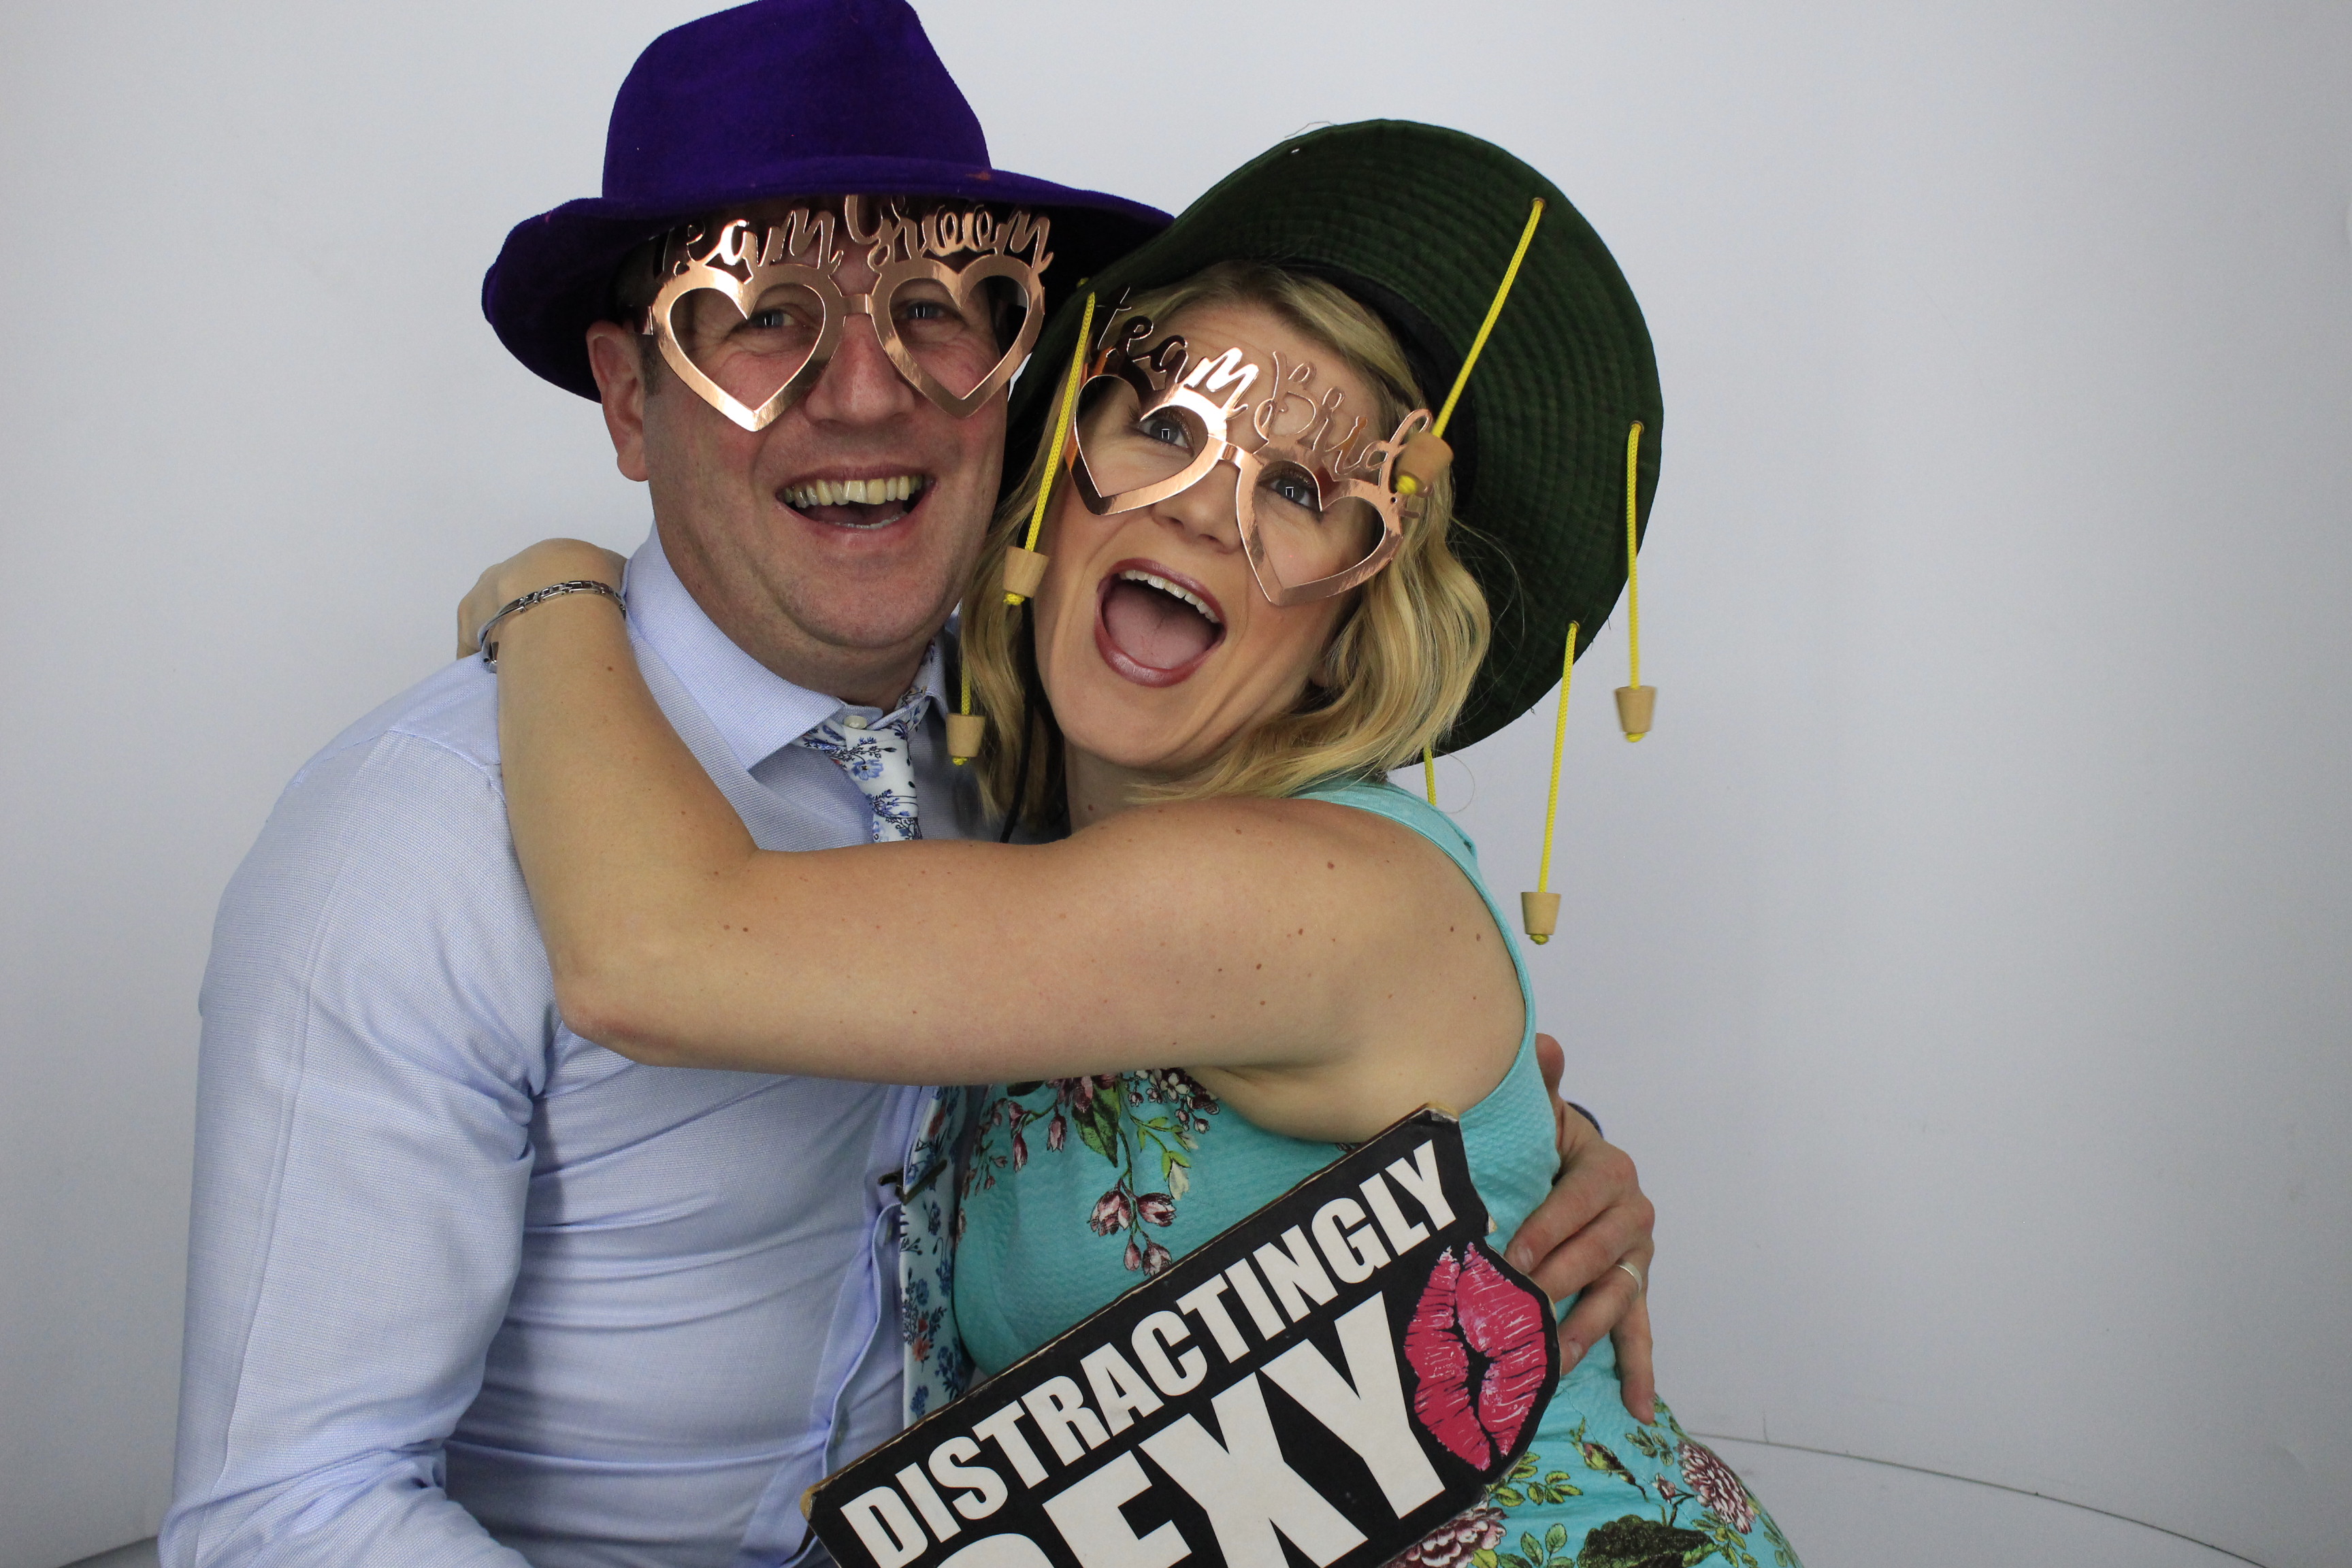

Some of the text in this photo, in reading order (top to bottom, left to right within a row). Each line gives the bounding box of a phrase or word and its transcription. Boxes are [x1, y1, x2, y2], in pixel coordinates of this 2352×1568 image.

[1253, 350, 1435, 495] Brid
[840, 1139, 1456, 1567] DISTRACTINGLY
[934, 1292, 1446, 1567] EXY
